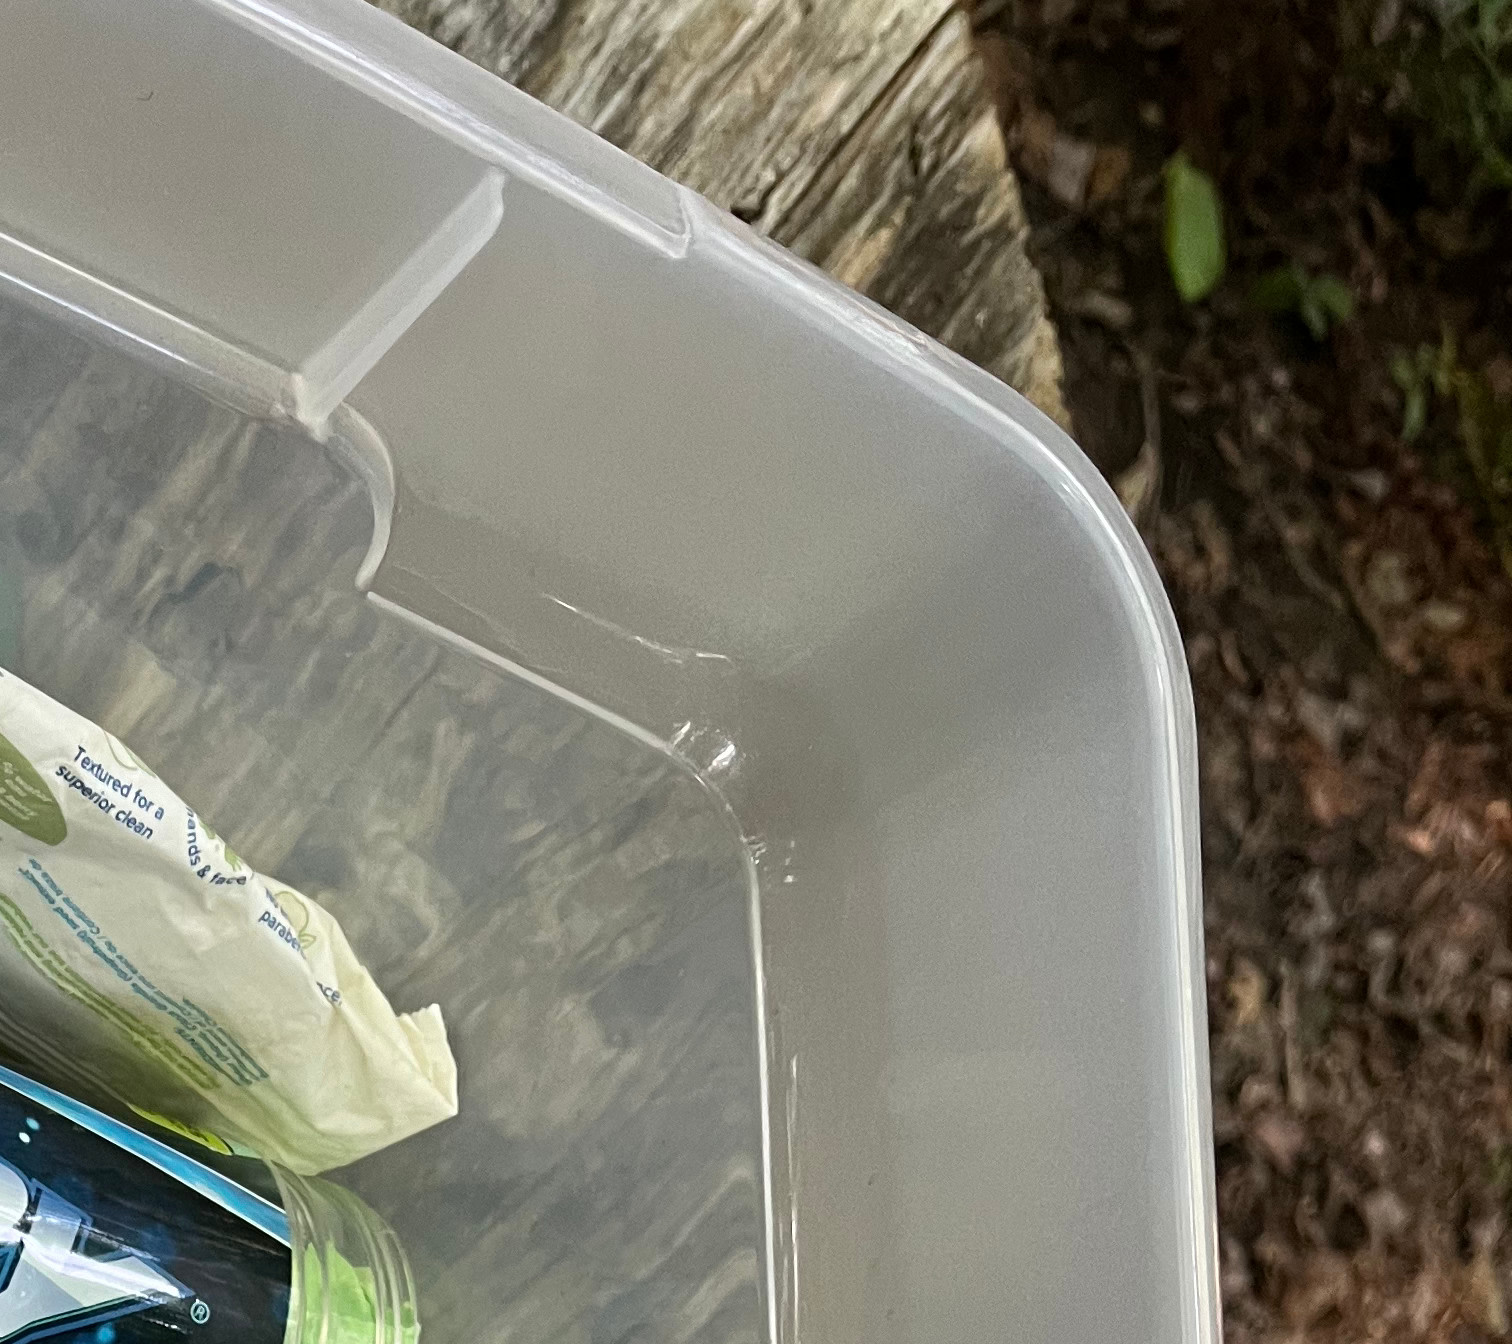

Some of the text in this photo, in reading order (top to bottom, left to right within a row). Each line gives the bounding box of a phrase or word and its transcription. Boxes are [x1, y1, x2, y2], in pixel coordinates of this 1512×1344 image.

[55, 764, 154, 839] superior clean
[74, 745, 166, 820] Textured for a
